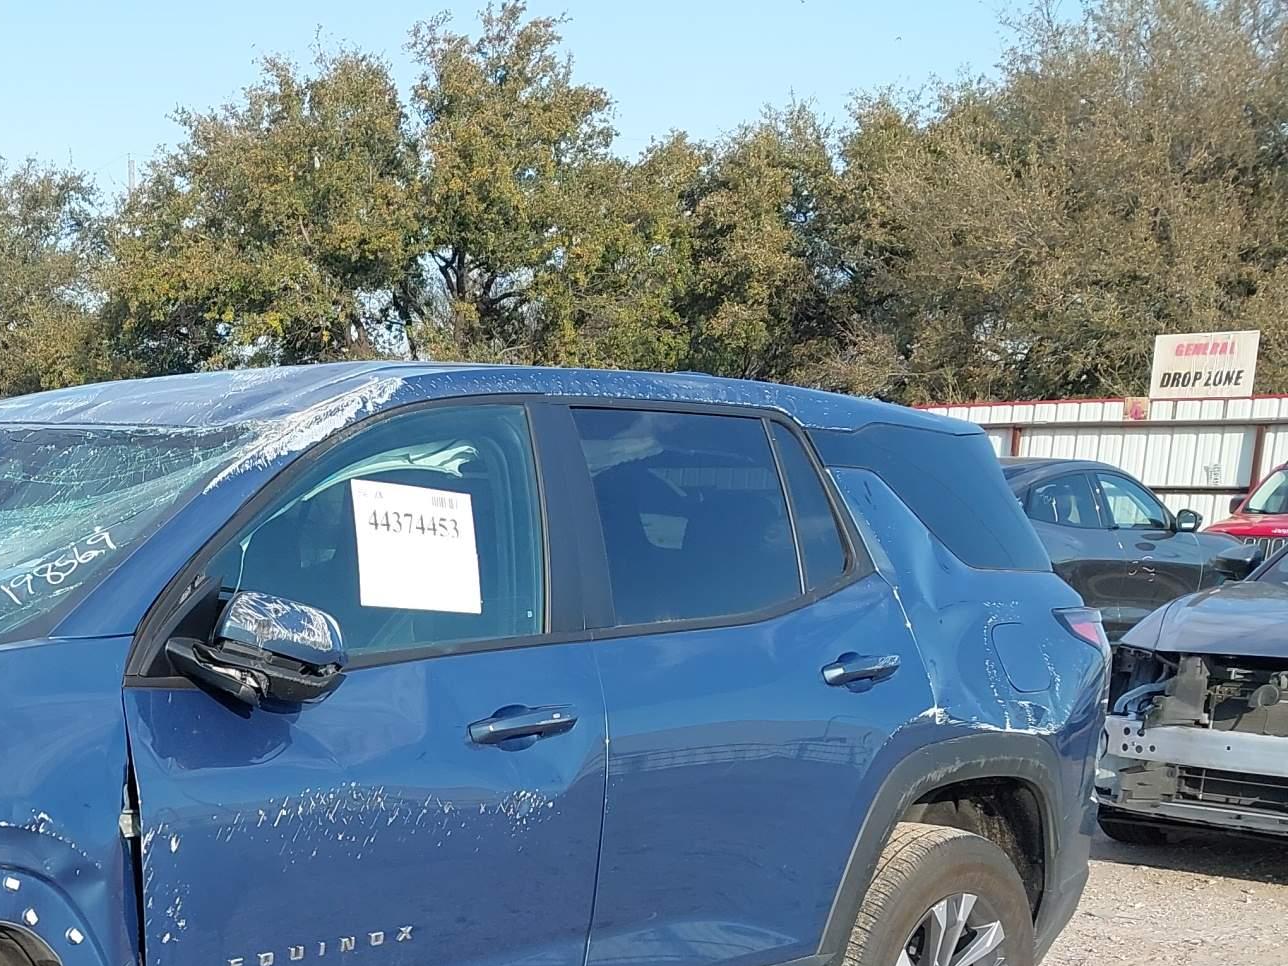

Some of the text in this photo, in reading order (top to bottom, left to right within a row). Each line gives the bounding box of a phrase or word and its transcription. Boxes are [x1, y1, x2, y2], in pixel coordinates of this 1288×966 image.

[1175, 341, 1236, 357] GENERAL
[1160, 369, 1245, 388] DROP ZONE
[368, 509, 460, 539] 44374453
[0, 527, 117, 606] 198569
